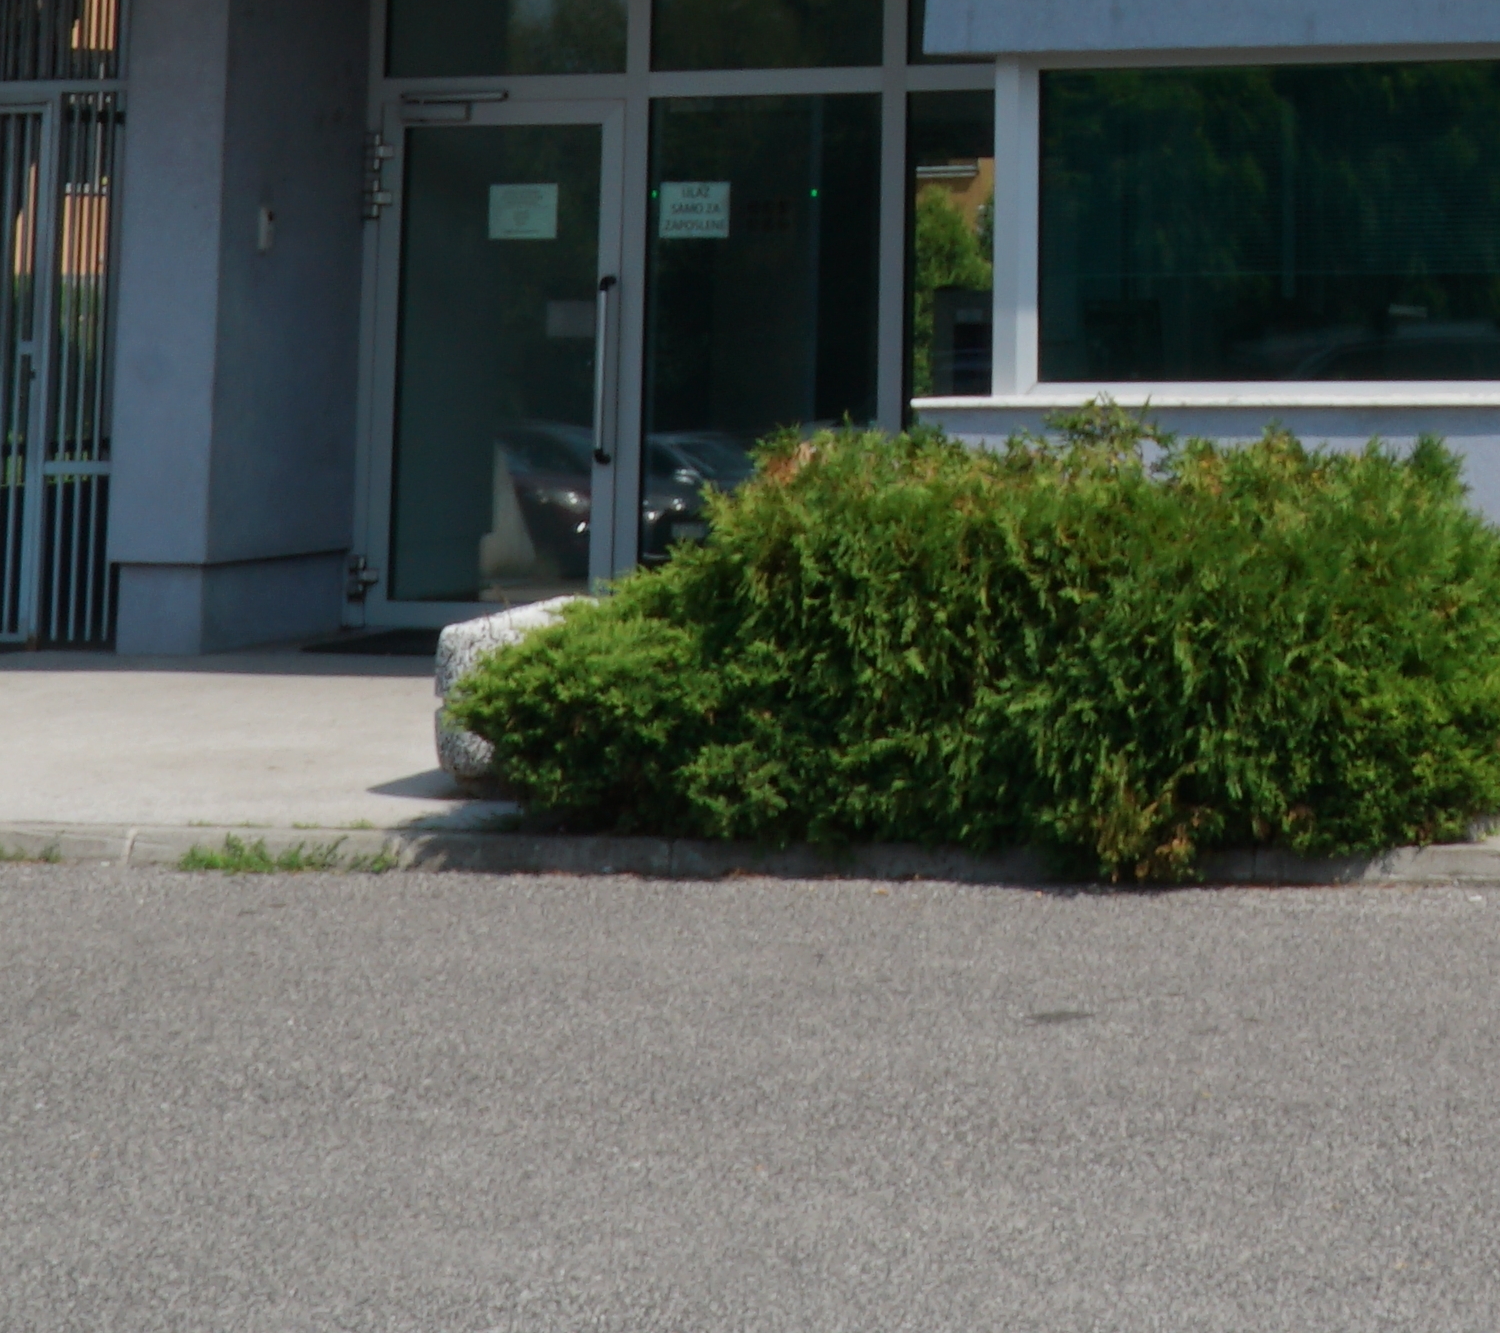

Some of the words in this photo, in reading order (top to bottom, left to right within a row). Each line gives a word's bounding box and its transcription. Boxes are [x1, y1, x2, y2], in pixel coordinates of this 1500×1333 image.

[682, 185, 710, 199] ULAZ
[671, 203, 704, 214] SAMO
[706, 203, 721, 214] ZA
[664, 219, 729, 231] ZAPOSLENE
